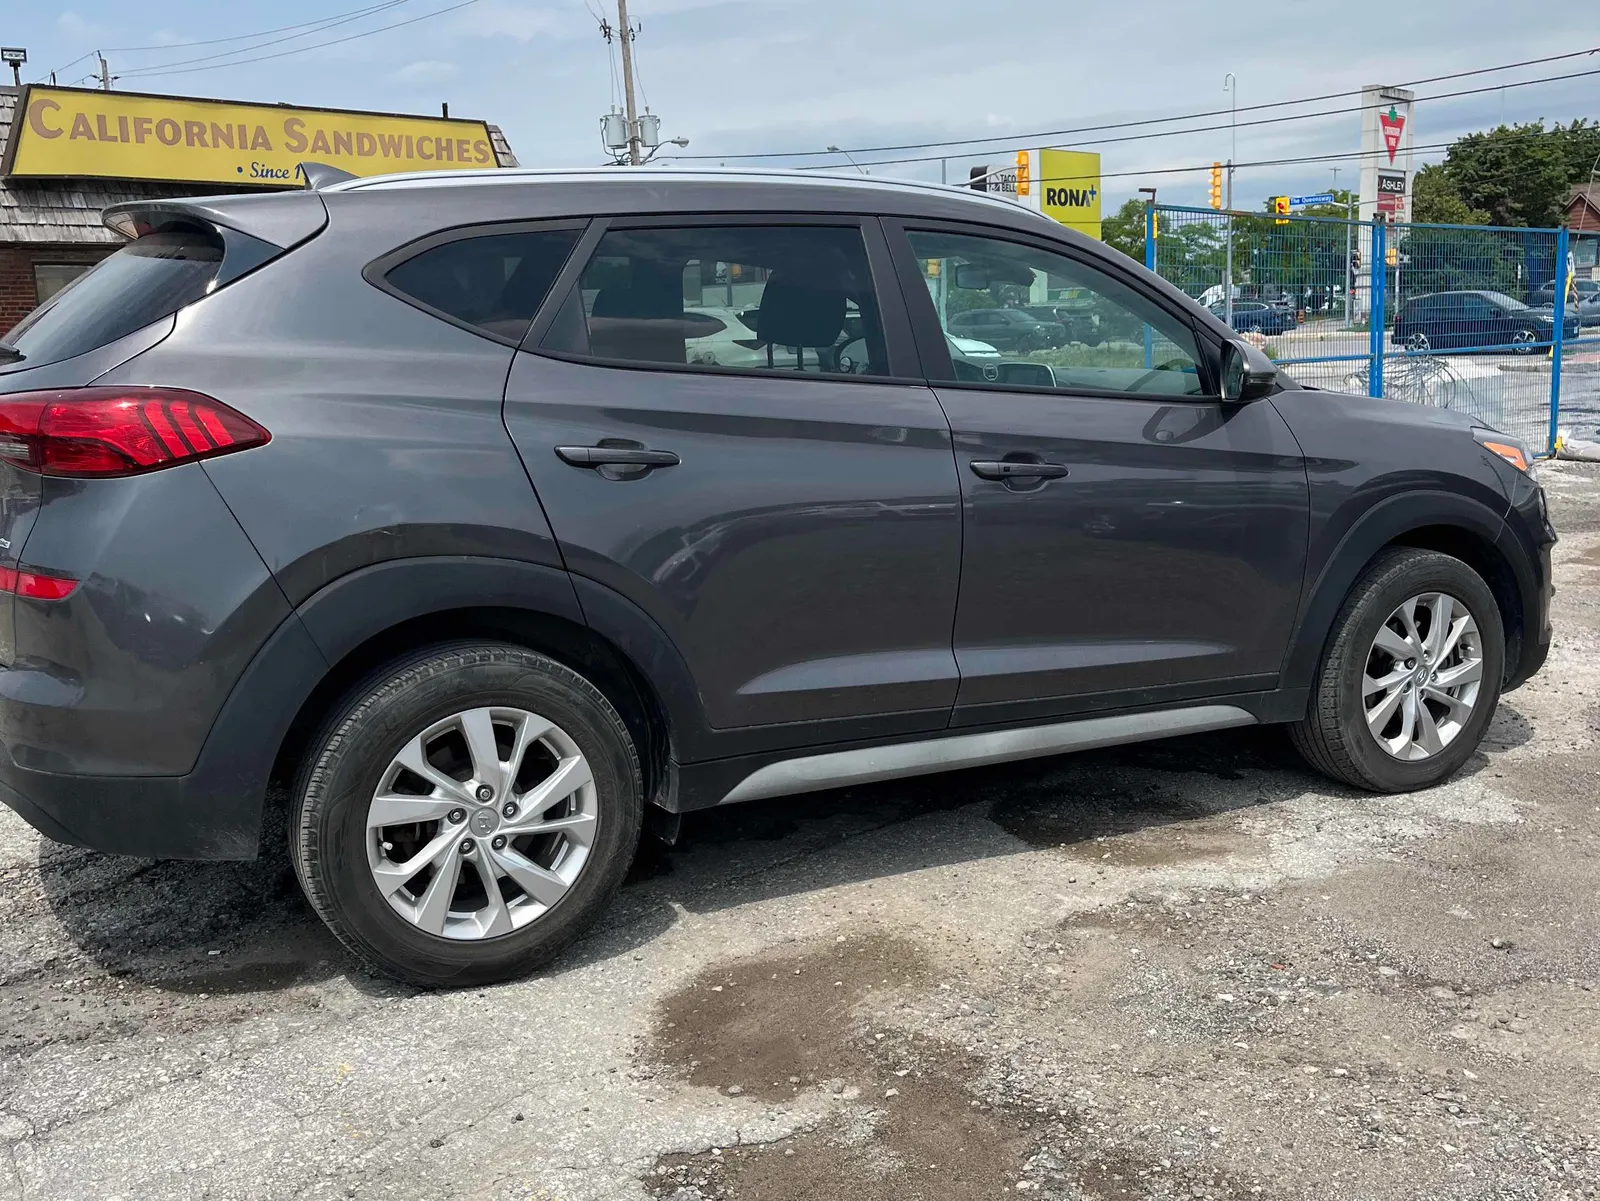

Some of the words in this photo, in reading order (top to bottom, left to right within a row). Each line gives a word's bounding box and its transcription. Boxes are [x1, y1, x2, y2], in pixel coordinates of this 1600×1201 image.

[28, 98, 272, 151] CALIFORNIA
[283, 117, 489, 164] SANDWICHES
[250, 161, 290, 179] Since
[1000, 174, 1016, 183] TACO
[1001, 183, 1016, 192] BELL
[1381, 178, 1405, 191] ASHLEY
[1290, 197, 1300, 205] The
